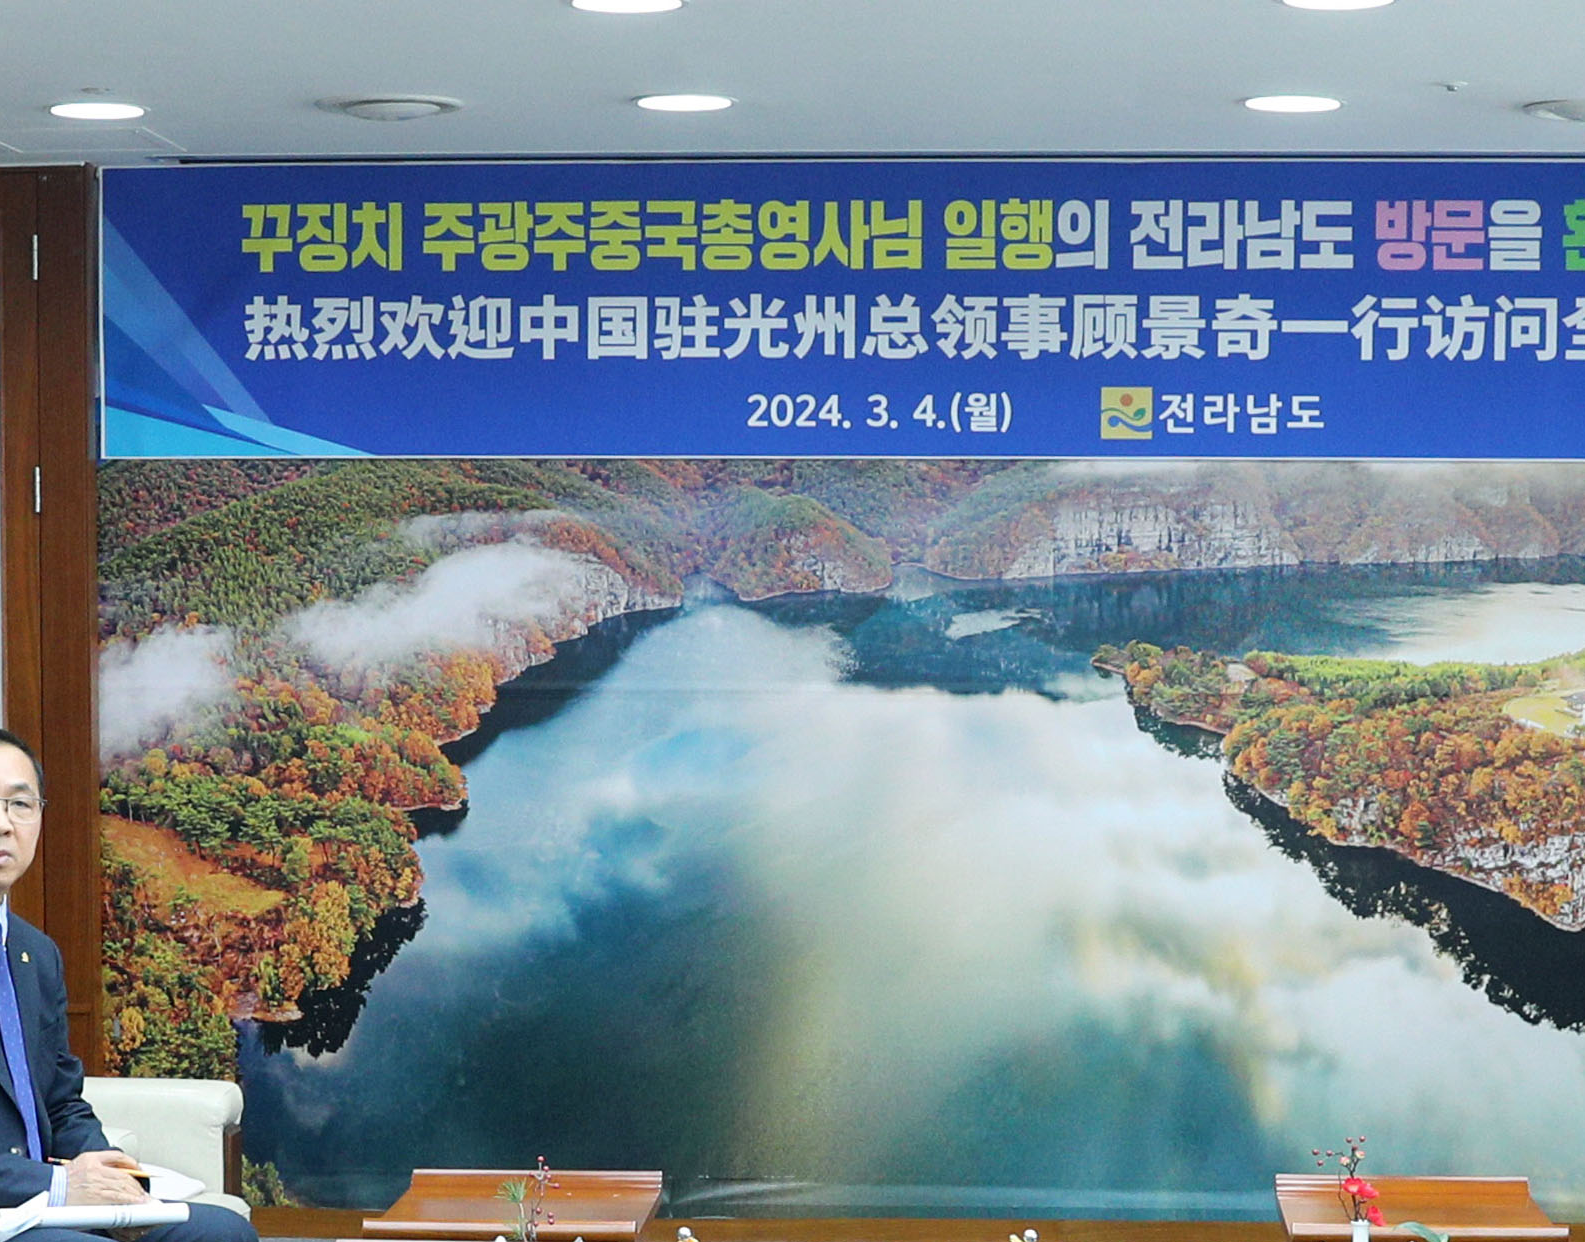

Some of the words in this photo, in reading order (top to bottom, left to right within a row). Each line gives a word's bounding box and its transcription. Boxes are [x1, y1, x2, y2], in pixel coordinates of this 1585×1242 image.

[242, 202, 402, 272] 꾸징치
[423, 199, 922, 271] 주광주중국총영사님
[944, 198, 1109, 270] 일행의
[1130, 199, 1354, 270] 전라남도
[1376, 200, 1543, 271] 방문을
[747, 393, 852, 429] 2024.
[866, 393, 899, 429] 3.
[912, 391, 1012, 434] 4.(월)
[1158, 392, 1325, 437] 전라남도
